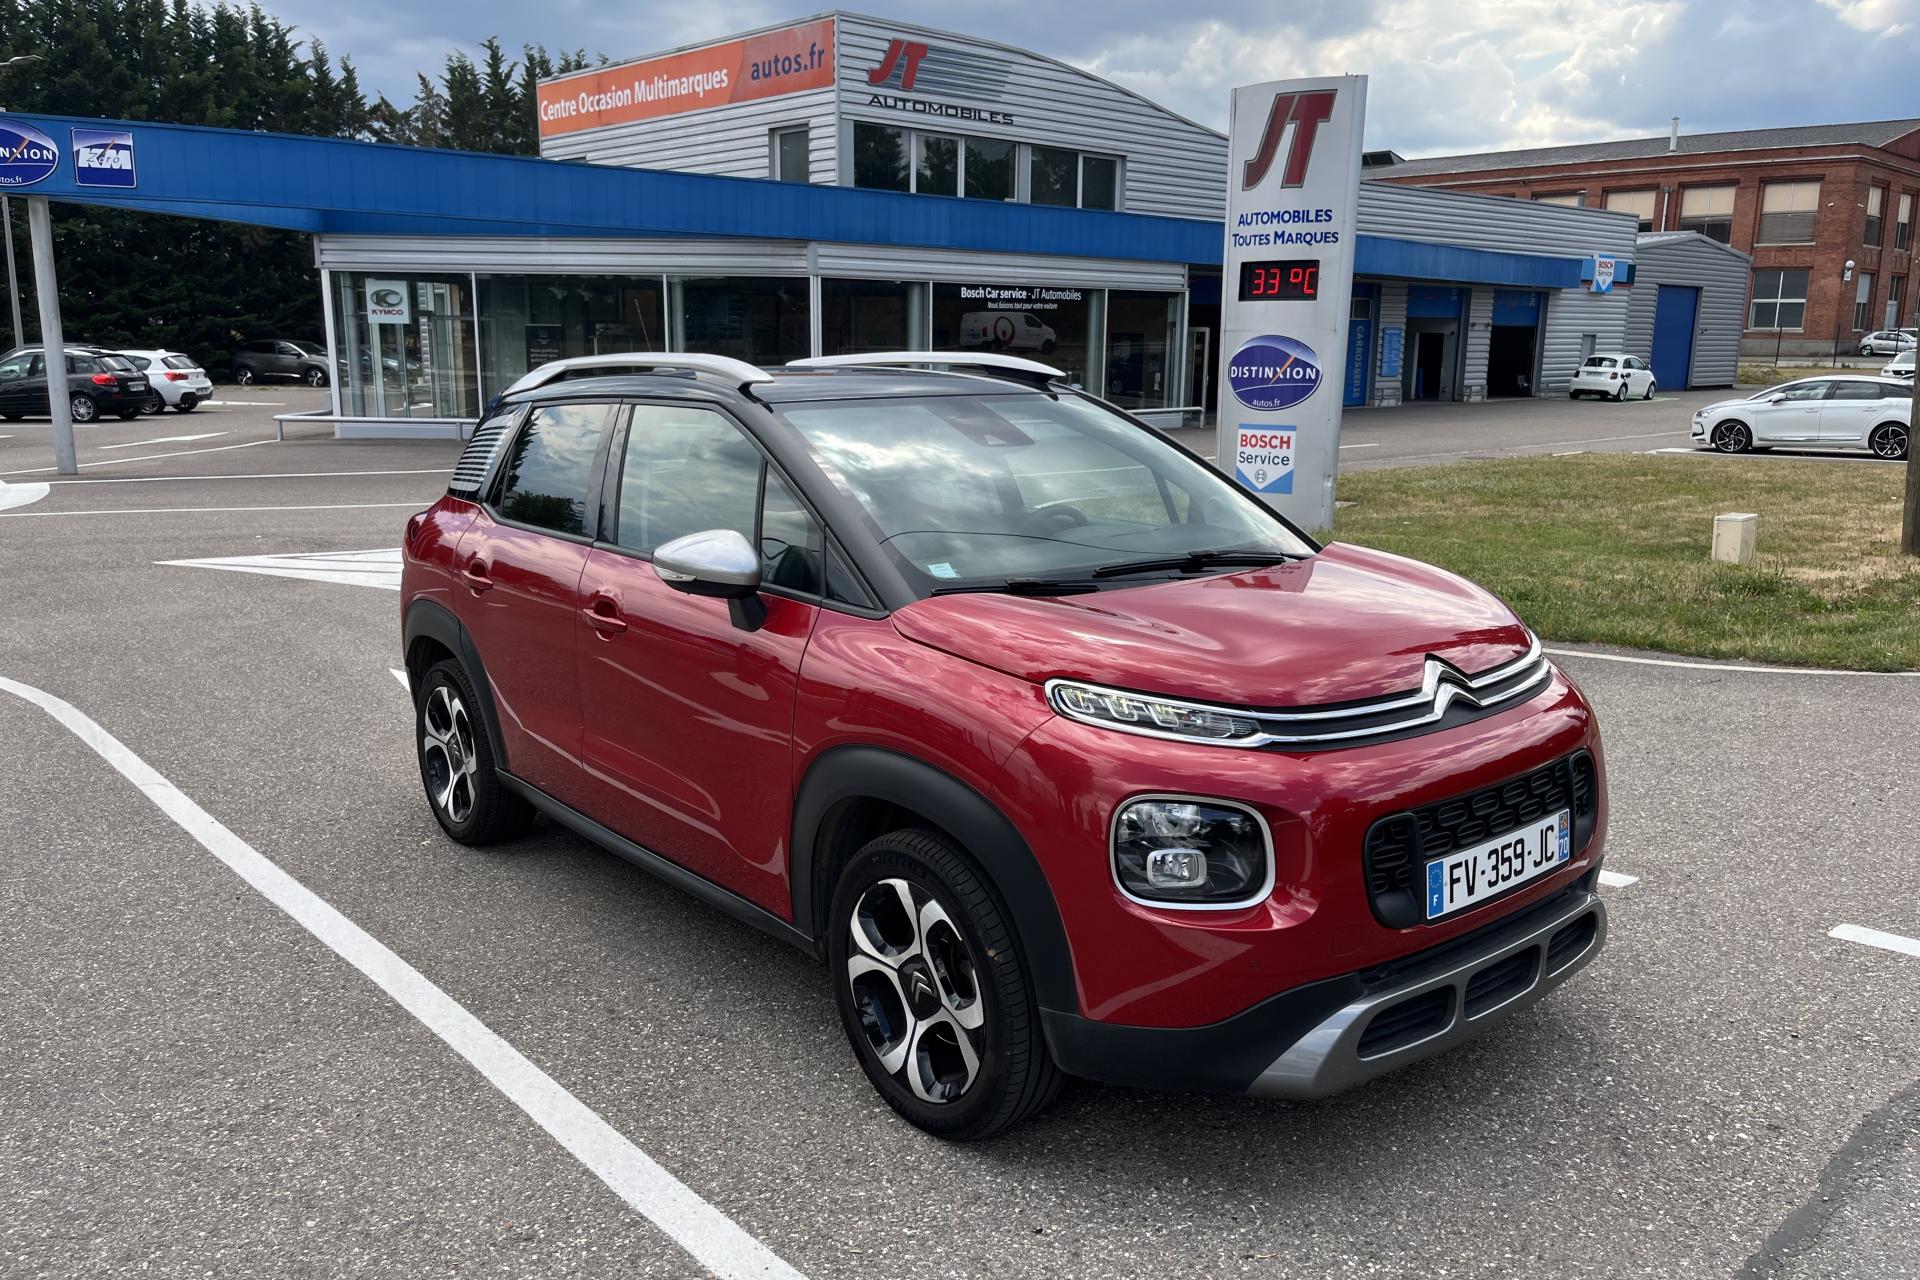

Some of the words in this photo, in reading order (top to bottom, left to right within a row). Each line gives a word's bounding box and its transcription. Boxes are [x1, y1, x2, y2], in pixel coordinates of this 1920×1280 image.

[751, 42, 825, 81] autos.fr
[868, 38, 929, 92] JT
[541, 100, 577, 121] Centre
[579, 86, 632, 114] Occasion
[634, 68, 728, 104] Multimarques
[868, 95, 1014, 125] AUTOMOBILES
[1242, 88, 1338, 191] JT
[86, 152, 120, 163] Zero
[1238, 209, 1333, 227] AUTOMOBILES
[1232, 233, 1270, 248] TOUTES
[1273, 230, 1339, 246] MARQUES
[1599, 261, 1613, 269] BOSCH
[1252, 268, 1281, 294] 33
[960, 287, 984, 298] Bosch
[985, 287, 999, 298] Car
[1000, 288, 1027, 299] service
[1031, 288, 1041, 299] JT
[1041, 289, 1081, 300] Automobiles
[371, 308, 404, 316] KYMCO
[1352, 326, 1365, 399] CARROSSERIE
[1230, 364, 1317, 381] DISTINXION
[1252, 397, 1281, 408] autos.fr
[1240, 433, 1291, 450] BOSCH
[1238, 451, 1290, 466] Service
[1449, 824, 1555, 904] FV-359-JC
[1433, 894, 1439, 907] F
